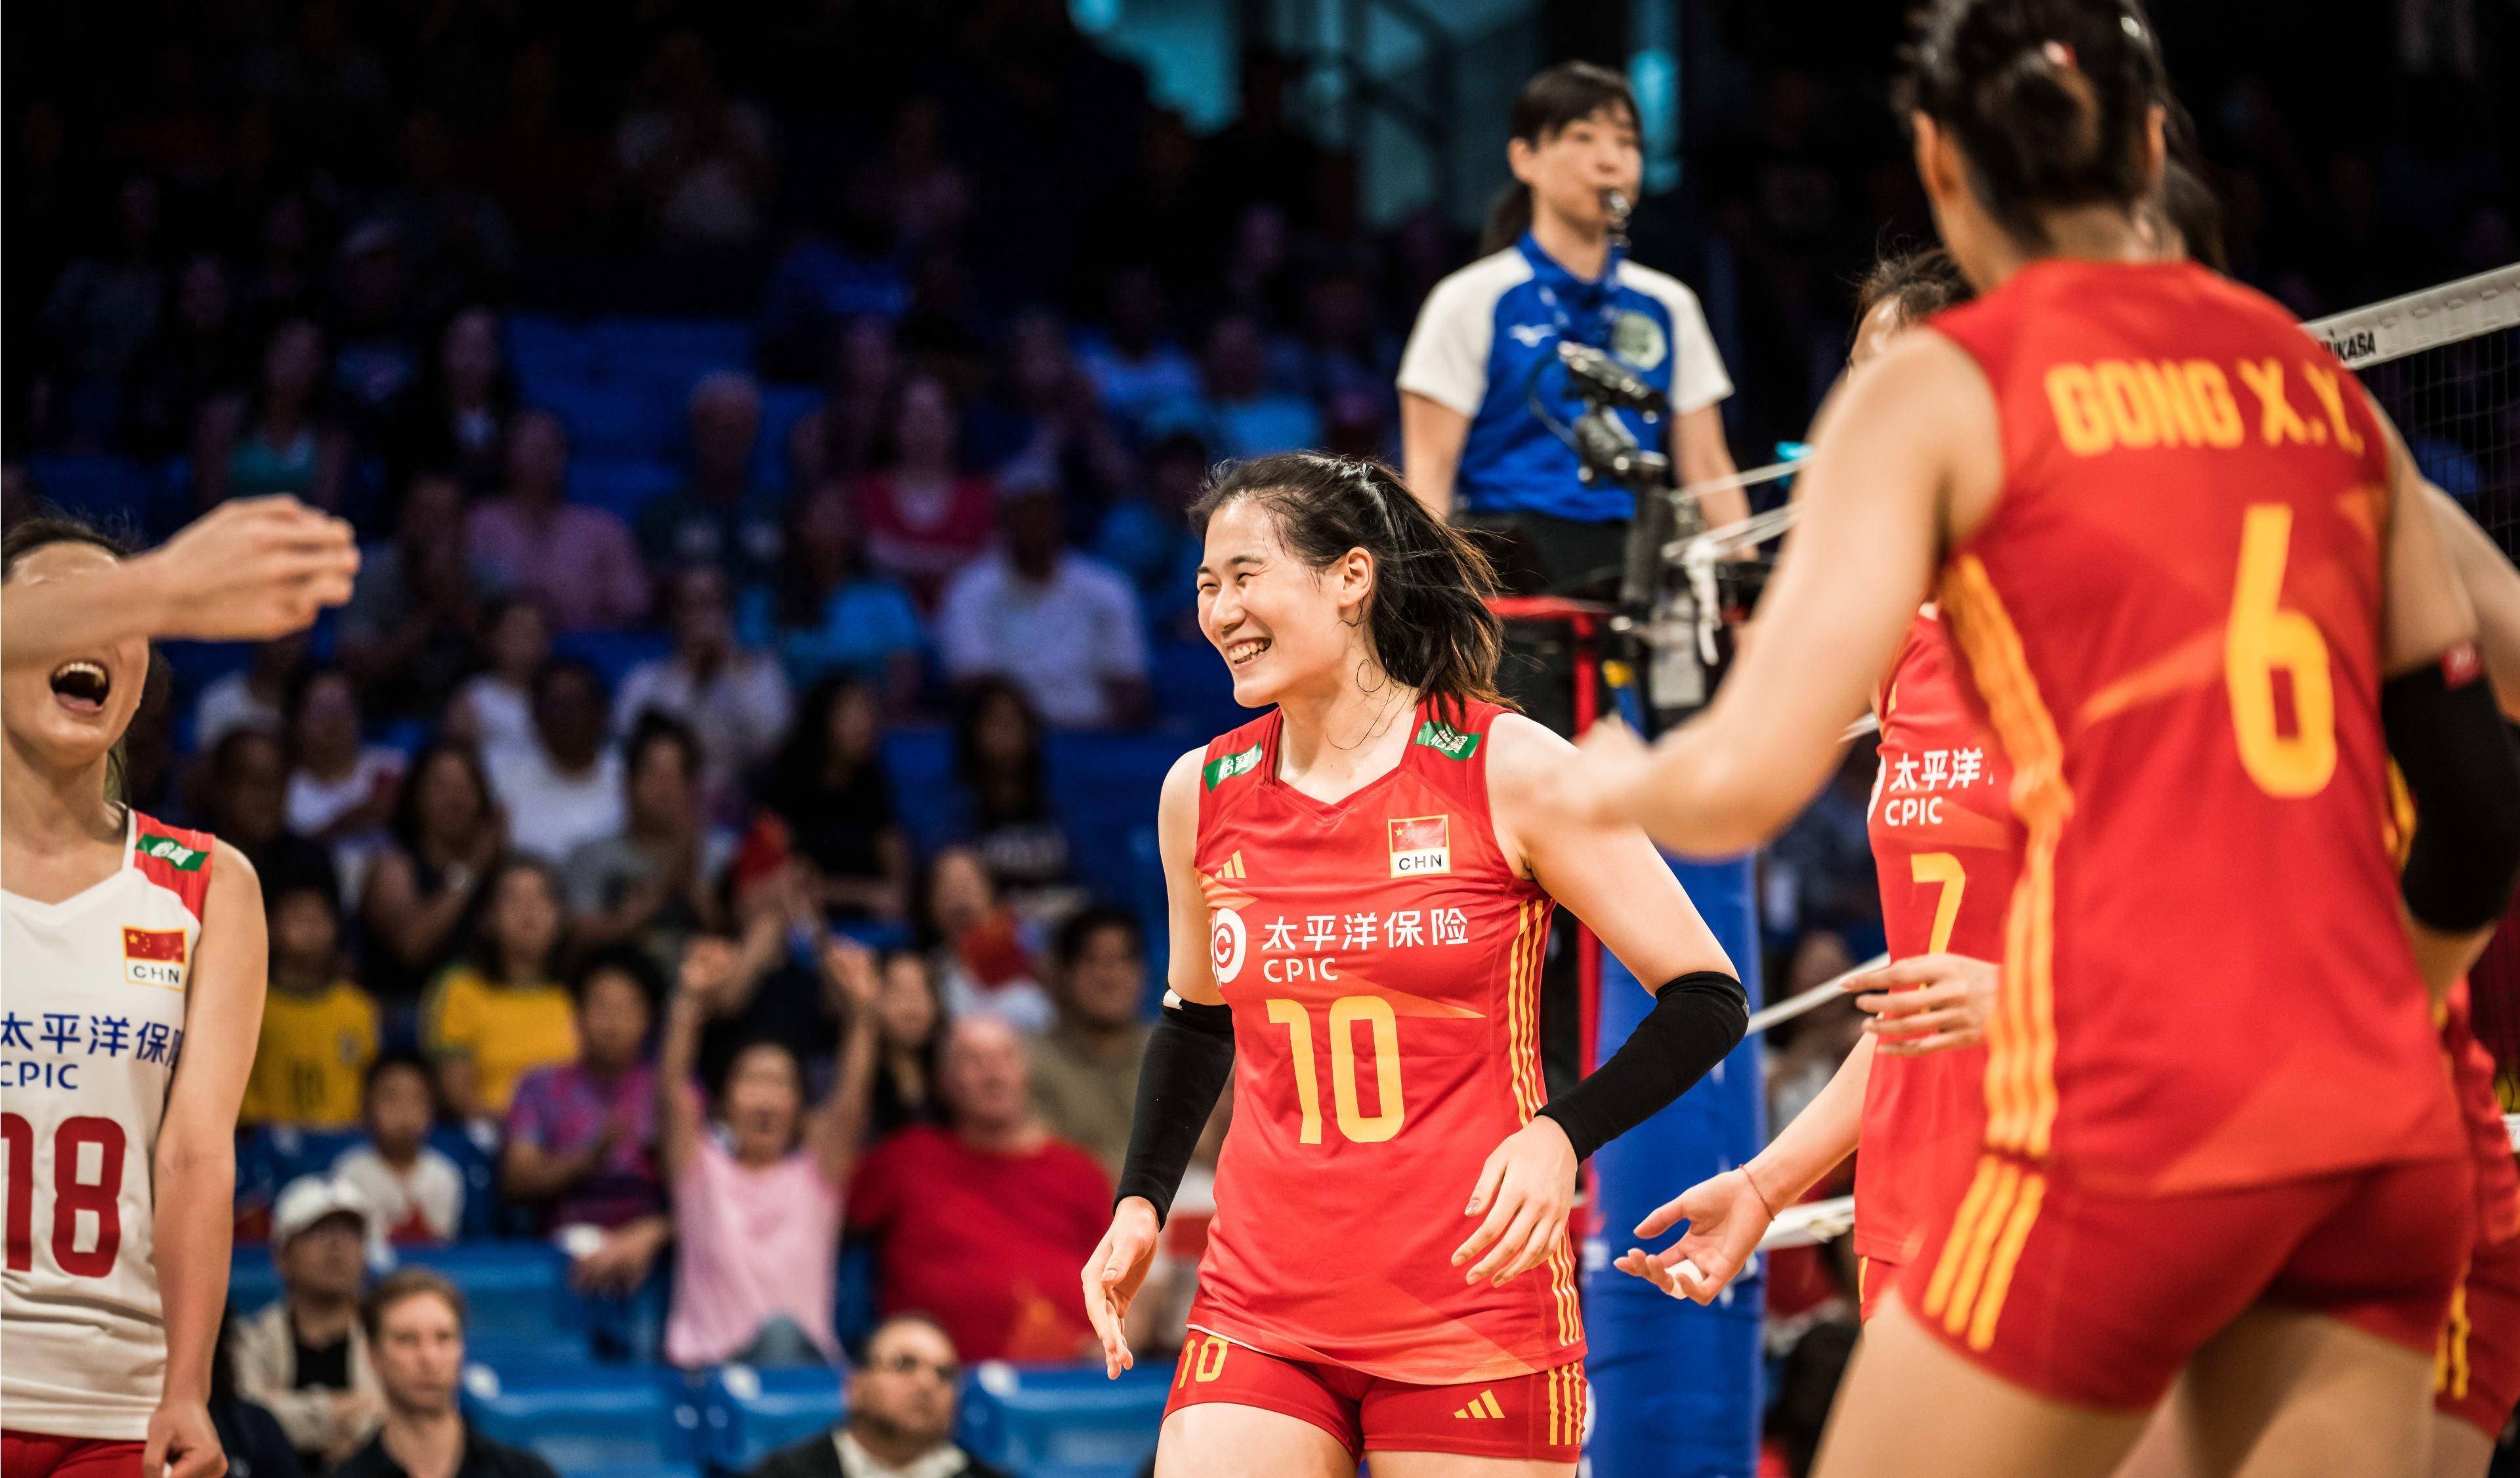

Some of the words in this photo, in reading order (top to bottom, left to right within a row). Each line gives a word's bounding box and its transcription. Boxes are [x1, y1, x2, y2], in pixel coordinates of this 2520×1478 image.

[2046, 358, 2244, 457] GONG
[2226, 503, 2338, 798] 6
[1889, 746, 1994, 793] 太平洋
[1885, 796, 1944, 826] CPIC
[1398, 854, 1442, 871] CHN
[1910, 852, 1966, 956] 7
[1261, 908, 1469, 951] 太平洋保险
[133, 965, 179, 984] CHN
[1263, 957, 1339, 984] CPIC
[1267, 995, 1405, 1145] 10
[0, 1112, 126, 1278] 18
[1179, 1336, 1229, 1388] 10
